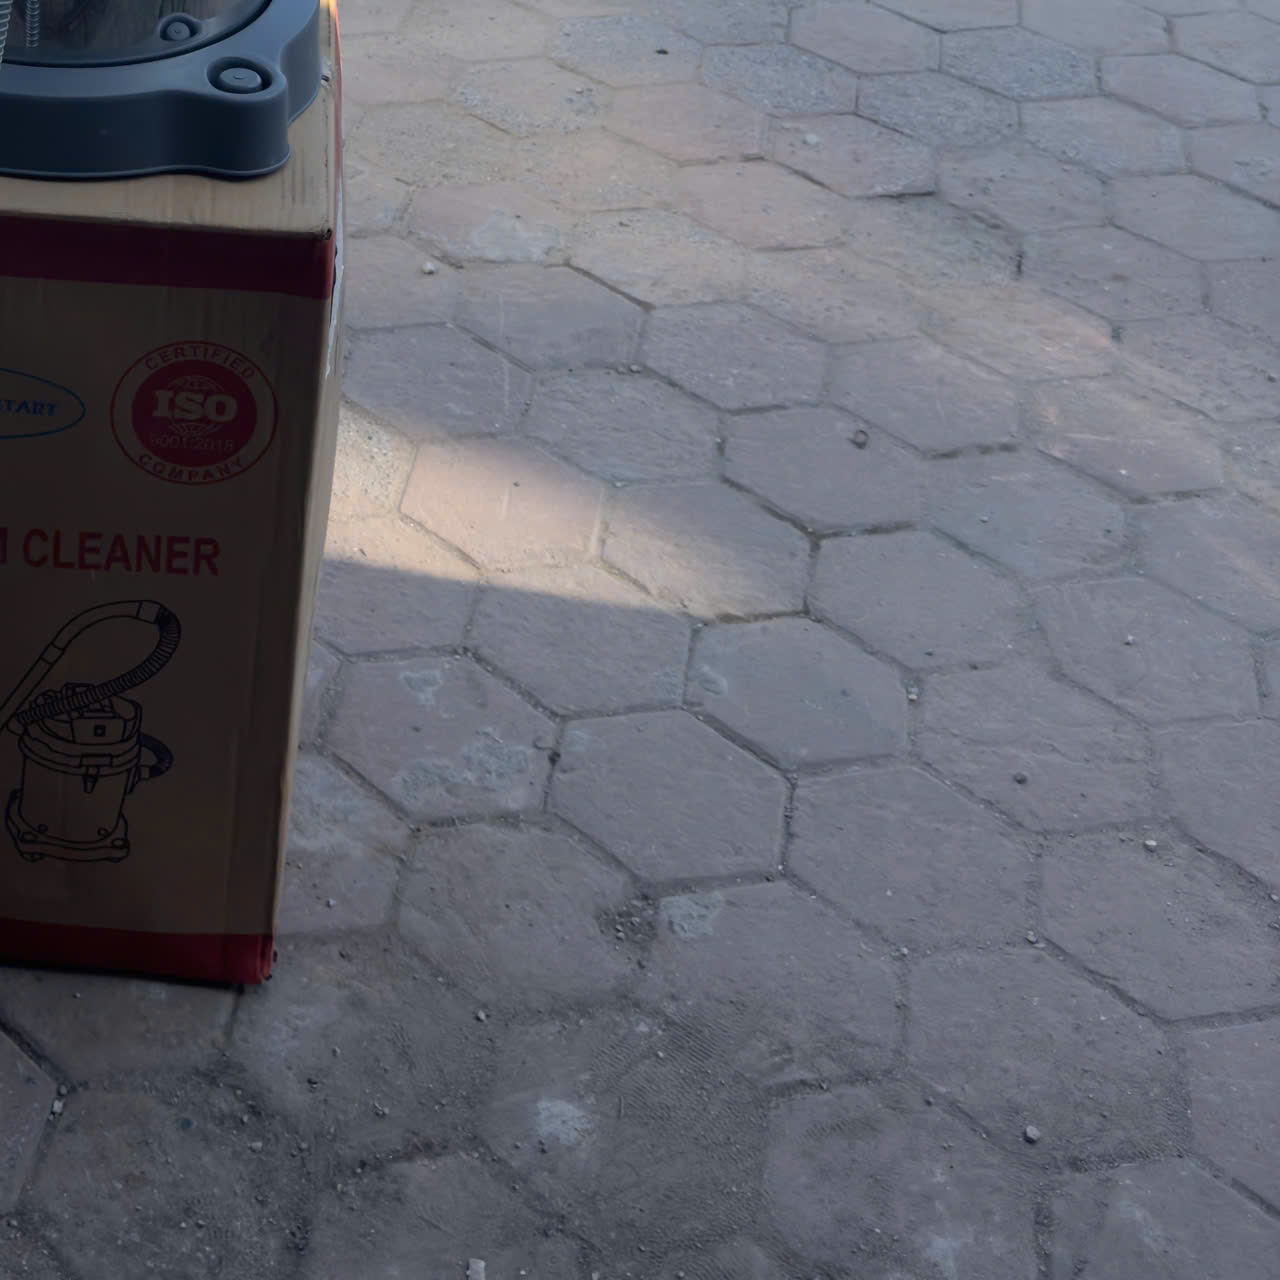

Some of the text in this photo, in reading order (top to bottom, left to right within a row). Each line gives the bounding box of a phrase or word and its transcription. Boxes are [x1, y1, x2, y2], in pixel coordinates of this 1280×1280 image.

[145, 346, 255, 379] CERTIFIED
[151, 389, 238, 424] ISO
[138, 453, 244, 481] COMPANY
[22, 528, 221, 577] CLEANER
